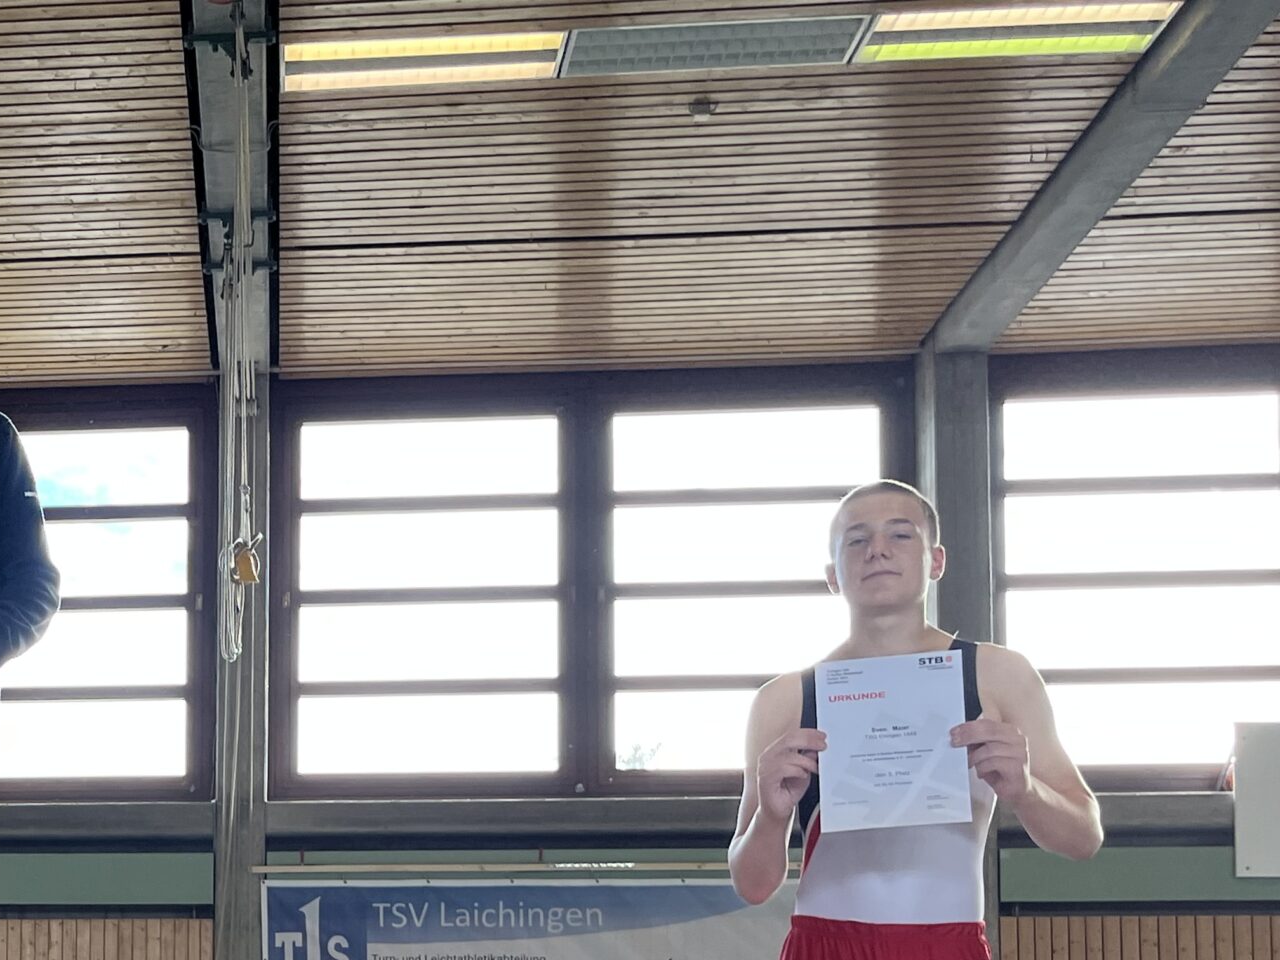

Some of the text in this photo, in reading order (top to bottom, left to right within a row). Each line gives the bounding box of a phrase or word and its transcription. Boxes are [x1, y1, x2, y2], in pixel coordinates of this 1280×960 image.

[918, 655, 944, 665] STB
[828, 691, 886, 703] URKUNDE
[372, 900, 603, 933] TSV Laichingen
